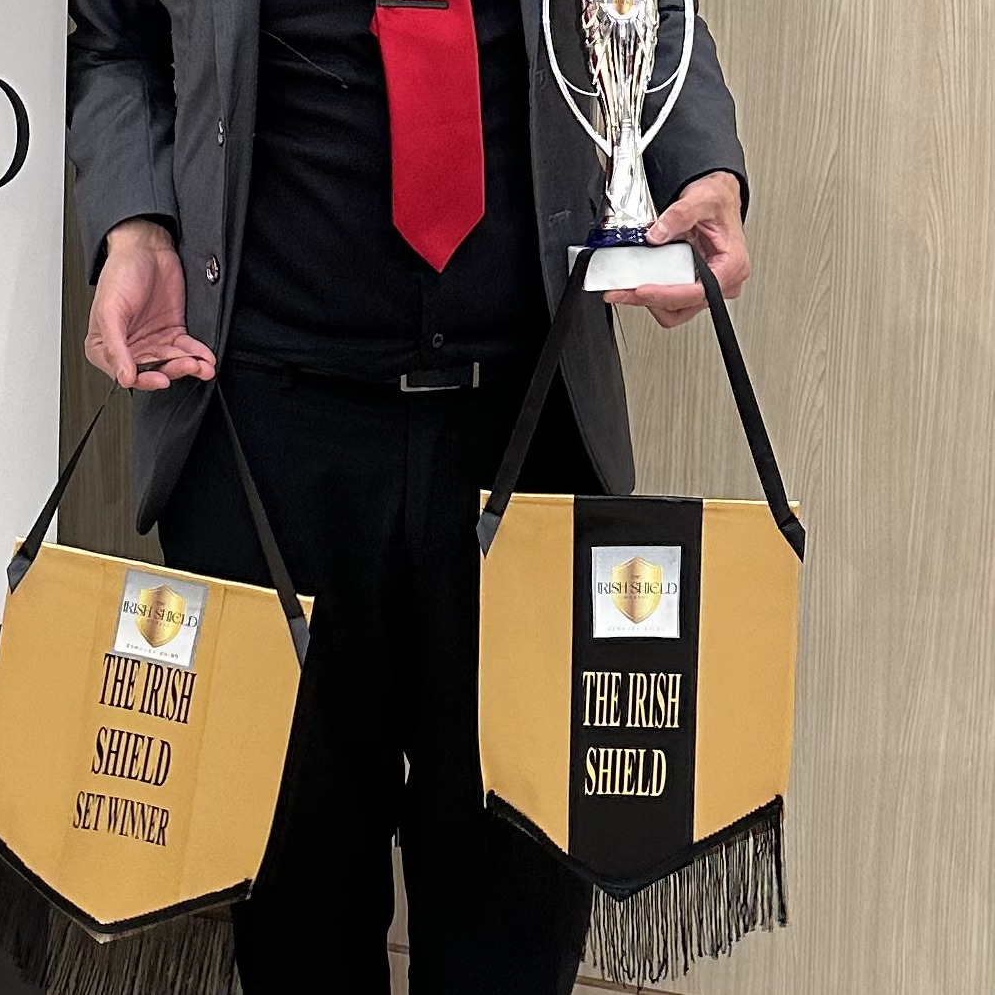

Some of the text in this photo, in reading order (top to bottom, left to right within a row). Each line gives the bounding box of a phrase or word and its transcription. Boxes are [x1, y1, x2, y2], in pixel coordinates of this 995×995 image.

[123, 600, 153, 618] IRISH
[155, 608, 198, 628] SHIELD
[597, 582, 678, 595] IRISH SHIELD
[98, 653, 197, 724] THE IRISH
[582, 671, 682, 729] THE IRISH
[91, 726, 172, 787] SHIELD
[584, 746, 667, 797] SHIELD
[73, 790, 170, 847] SET WINNER
